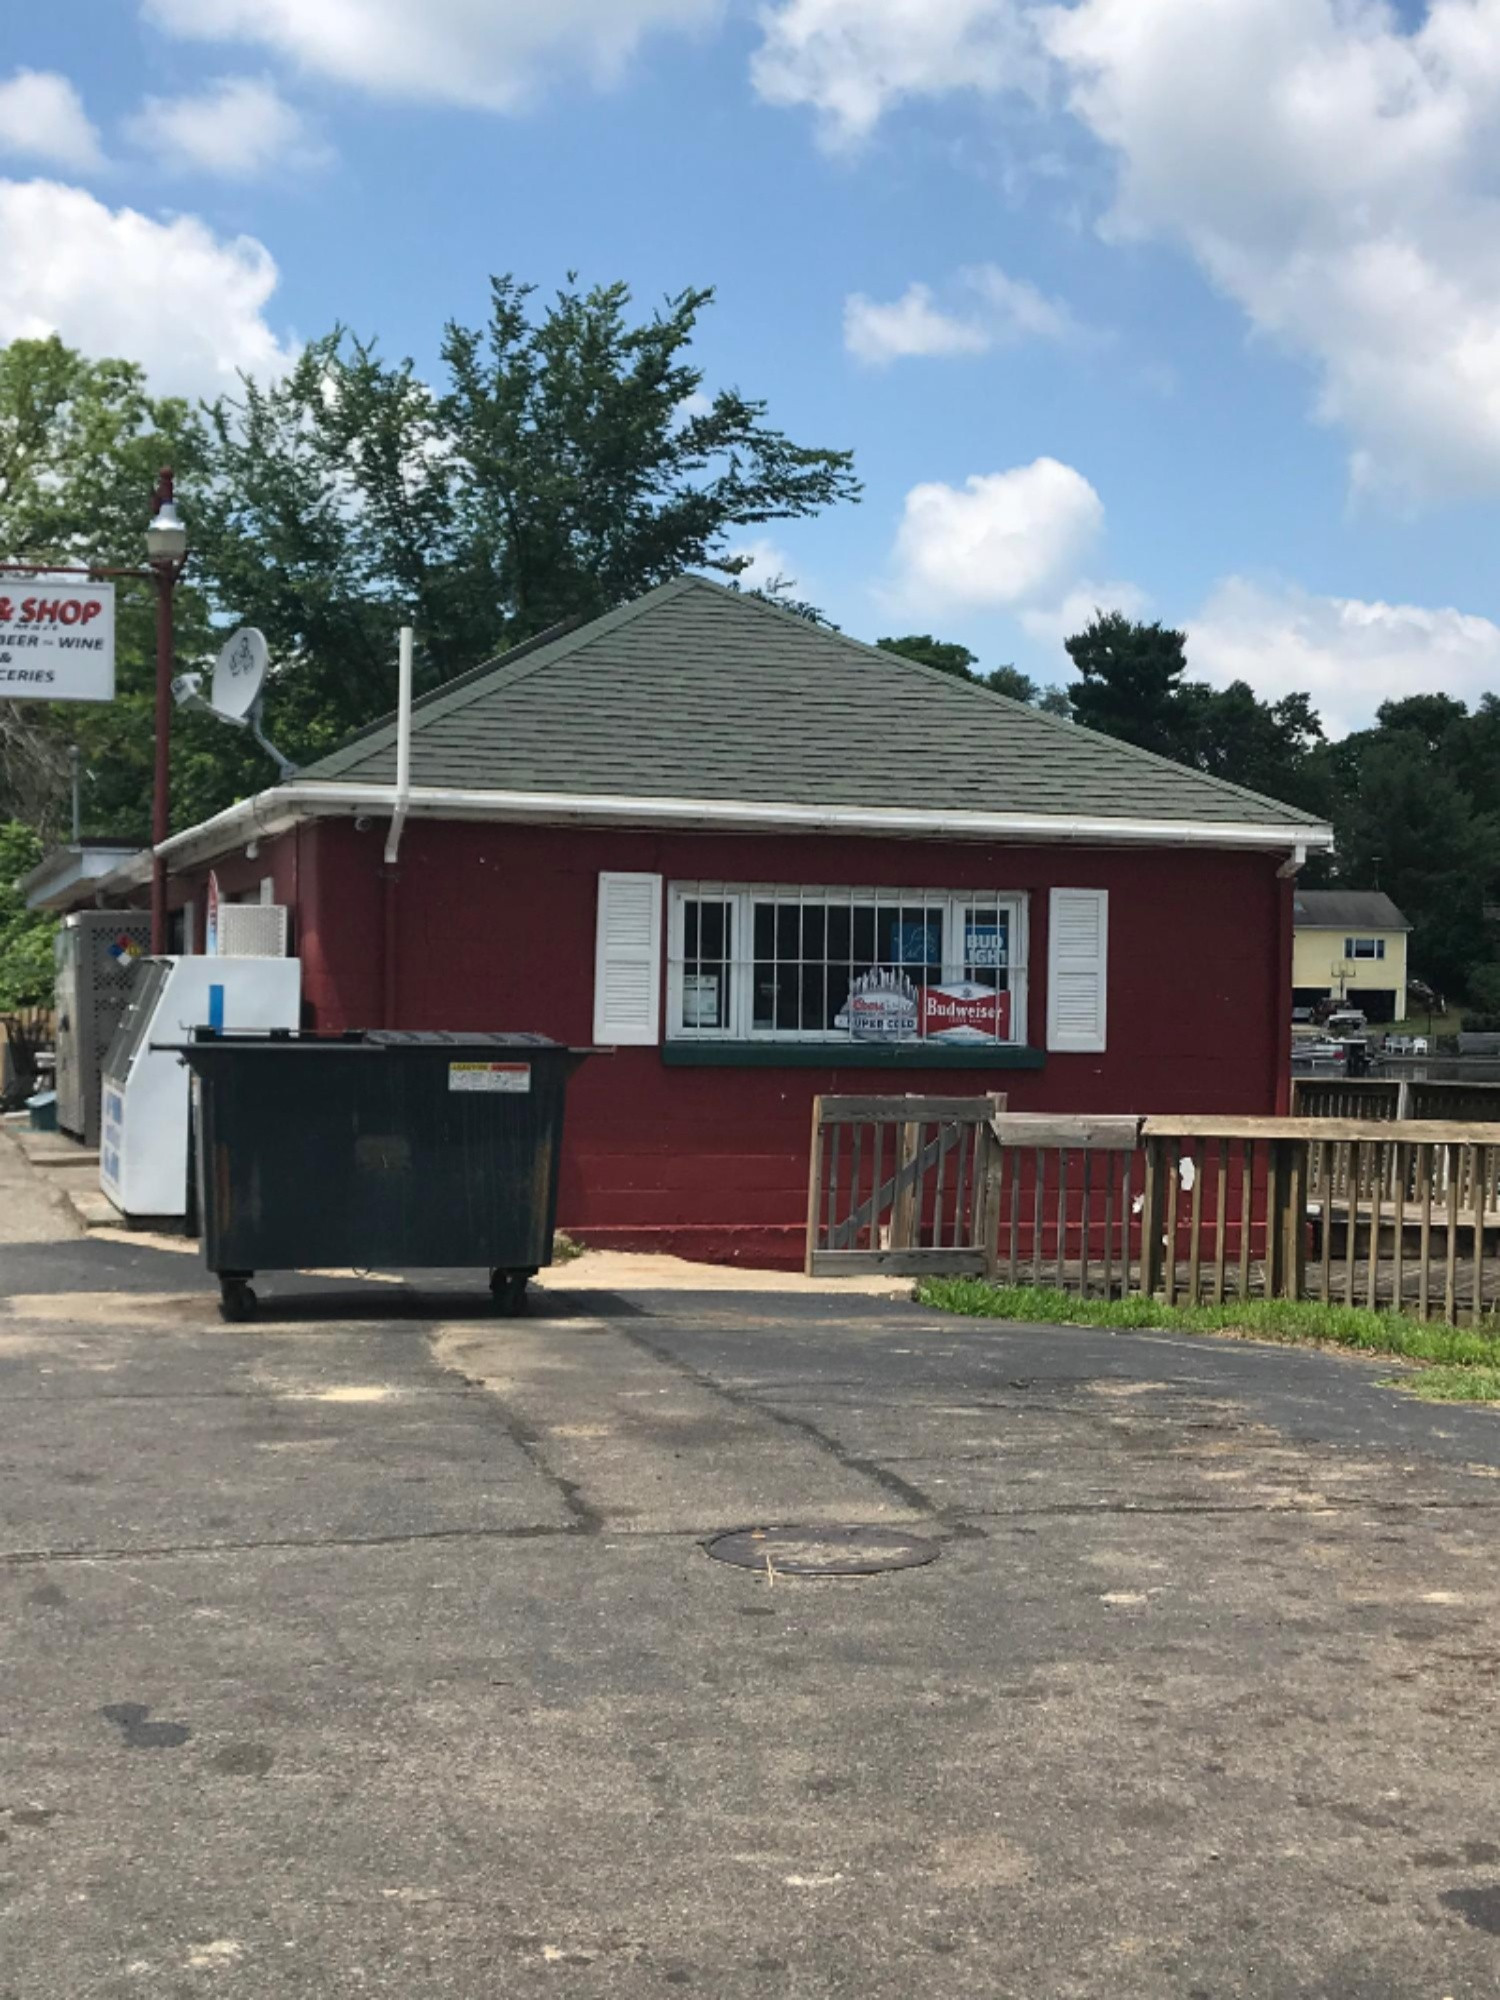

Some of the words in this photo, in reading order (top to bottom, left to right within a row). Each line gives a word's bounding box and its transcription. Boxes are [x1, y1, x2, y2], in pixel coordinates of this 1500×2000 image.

[20, 597, 101, 625] SHOP
[59, 637, 104, 651] WINE
[966, 934, 1004, 949] BUD
[927, 997, 1003, 1019] Budweiser
